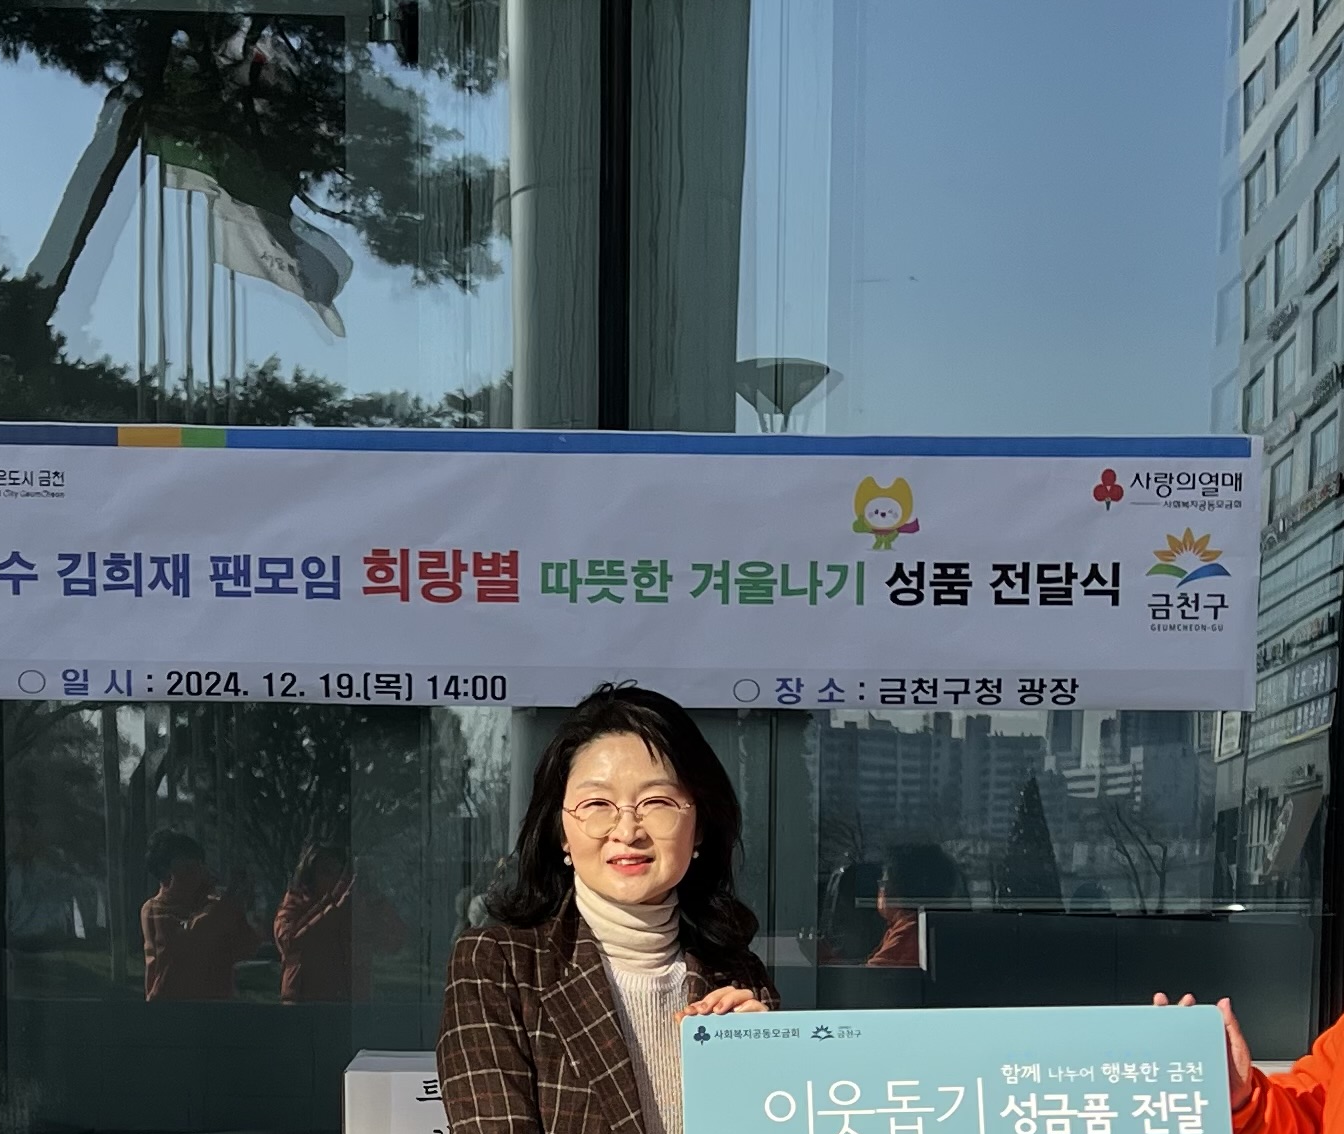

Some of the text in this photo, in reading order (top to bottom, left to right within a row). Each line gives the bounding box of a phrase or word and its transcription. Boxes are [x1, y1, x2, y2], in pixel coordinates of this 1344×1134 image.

[38, 470, 66, 487] 금천
[1130, 472, 1243, 498] 사랑의열매
[56, 551, 191, 599] 김희재
[208, 553, 341, 601] 팬모임
[362, 548, 520, 604] 희랑별
[541, 558, 674, 604] 따뜻한
[689, 559, 865, 606] 겨울나기
[884, 560, 973, 607] 성품
[988, 561, 1121, 607] 전달식
[1147, 592, 1229, 620] 금천구
[166, 670, 249, 697] 2024.
[262, 672, 305, 698] 12.
[426, 675, 507, 701] 14:00
[878, 677, 1004, 706] 금천구청
[1017, 677, 1079, 705] 광장
[1000, 1061, 1205, 1086] 함께 나누어 행복한 금천
